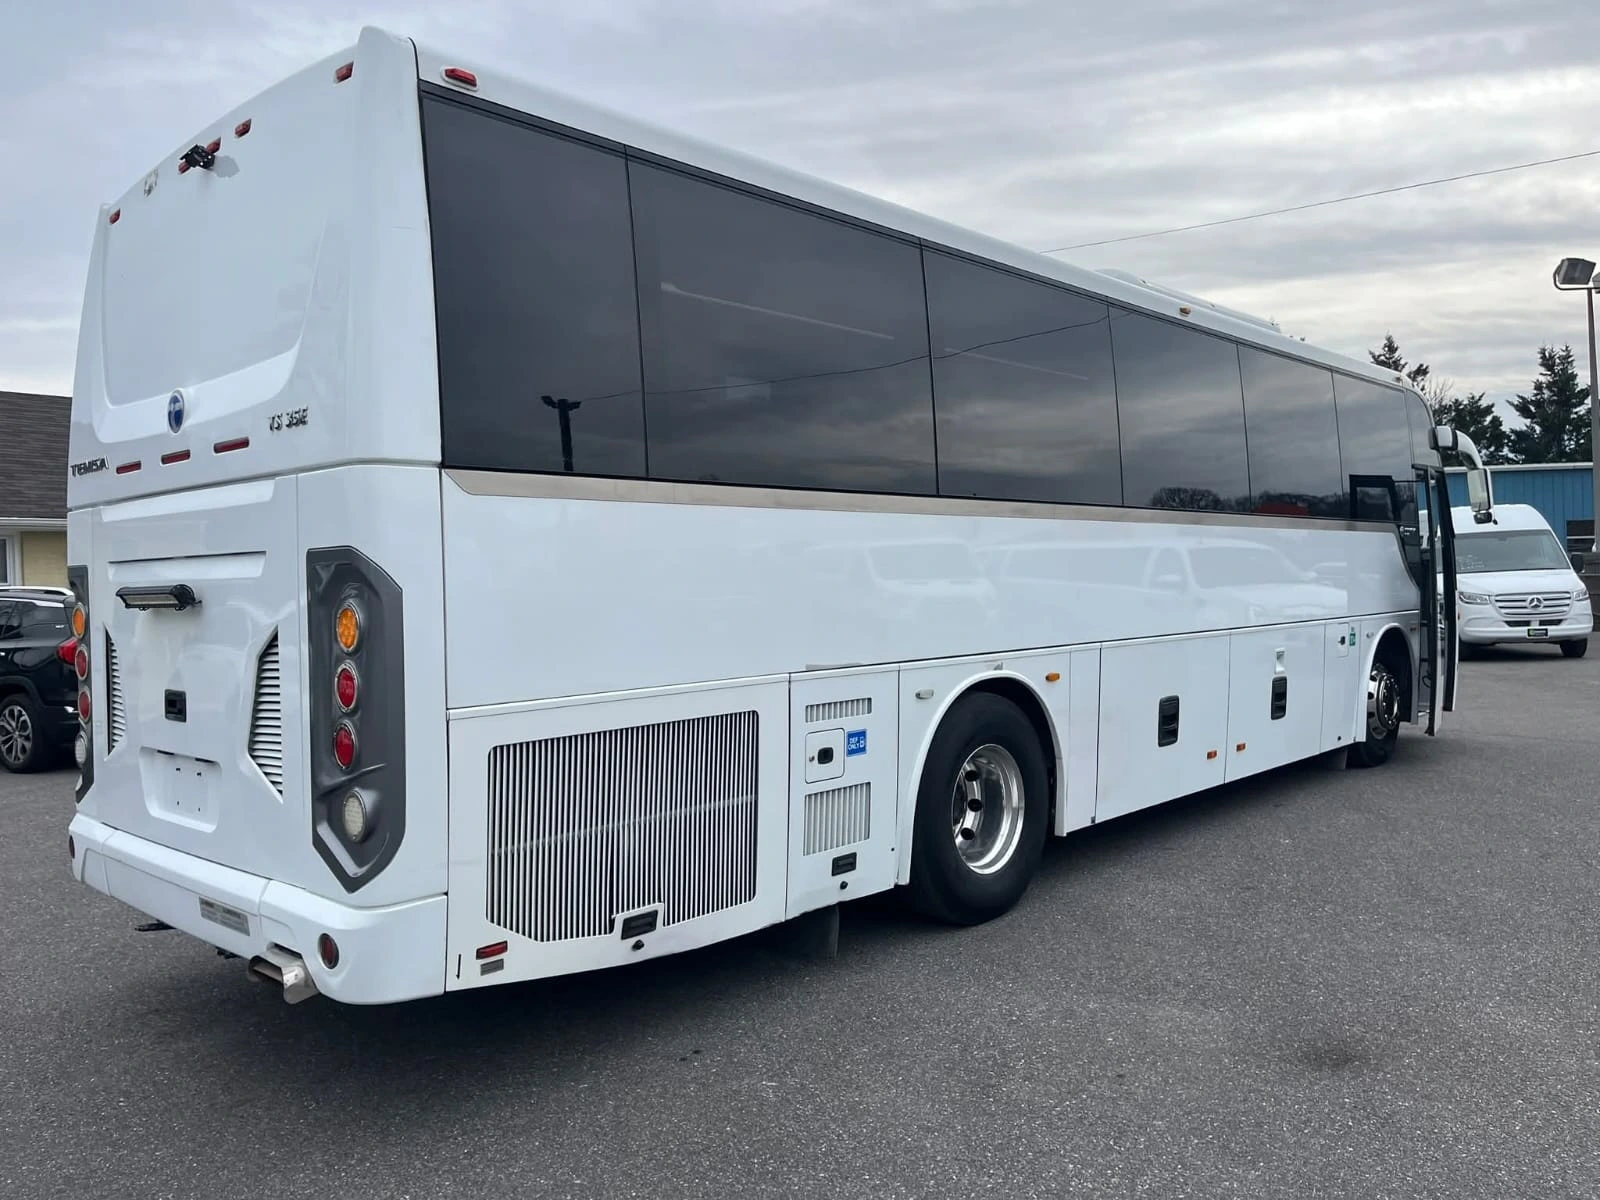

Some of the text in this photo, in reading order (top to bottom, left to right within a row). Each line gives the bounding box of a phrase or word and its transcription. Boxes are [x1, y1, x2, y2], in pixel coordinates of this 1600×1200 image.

[70, 456, 109, 477] TEMSA
[849, 736, 858, 744] DEF
[848, 742, 860, 750] ONLY
